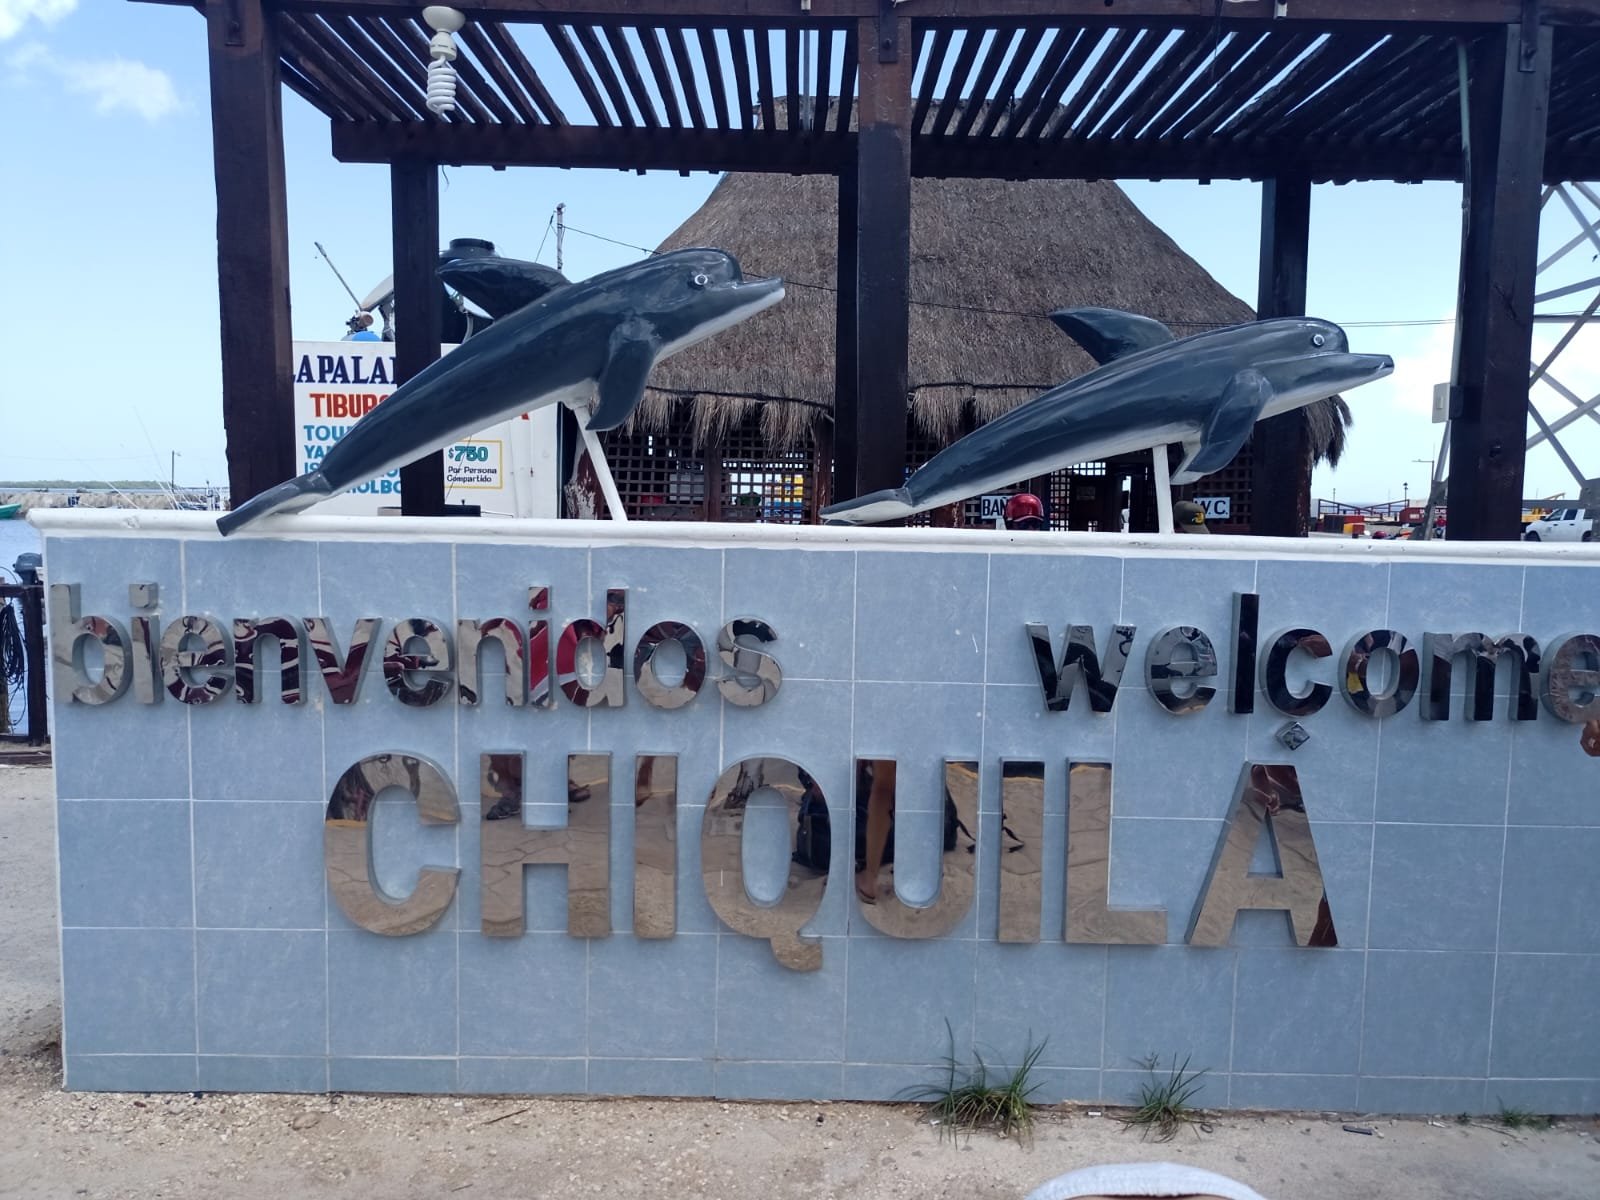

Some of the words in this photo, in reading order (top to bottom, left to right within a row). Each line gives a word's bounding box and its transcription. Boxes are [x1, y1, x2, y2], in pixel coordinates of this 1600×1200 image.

[292, 354, 396, 385] APALA
[309, 393, 390, 418] TIBUR
[304, 425, 353, 441] TOU
[448, 446, 489, 462] $750
[446, 474, 492, 483] Compartido
[448, 466, 462, 474] Por
[463, 466, 497, 474] Persona
[50, 583, 783, 709] bienvenidos
[1025, 593, 1600, 725] welcome
[324, 720, 1339, 972] CHIQUILÁ
